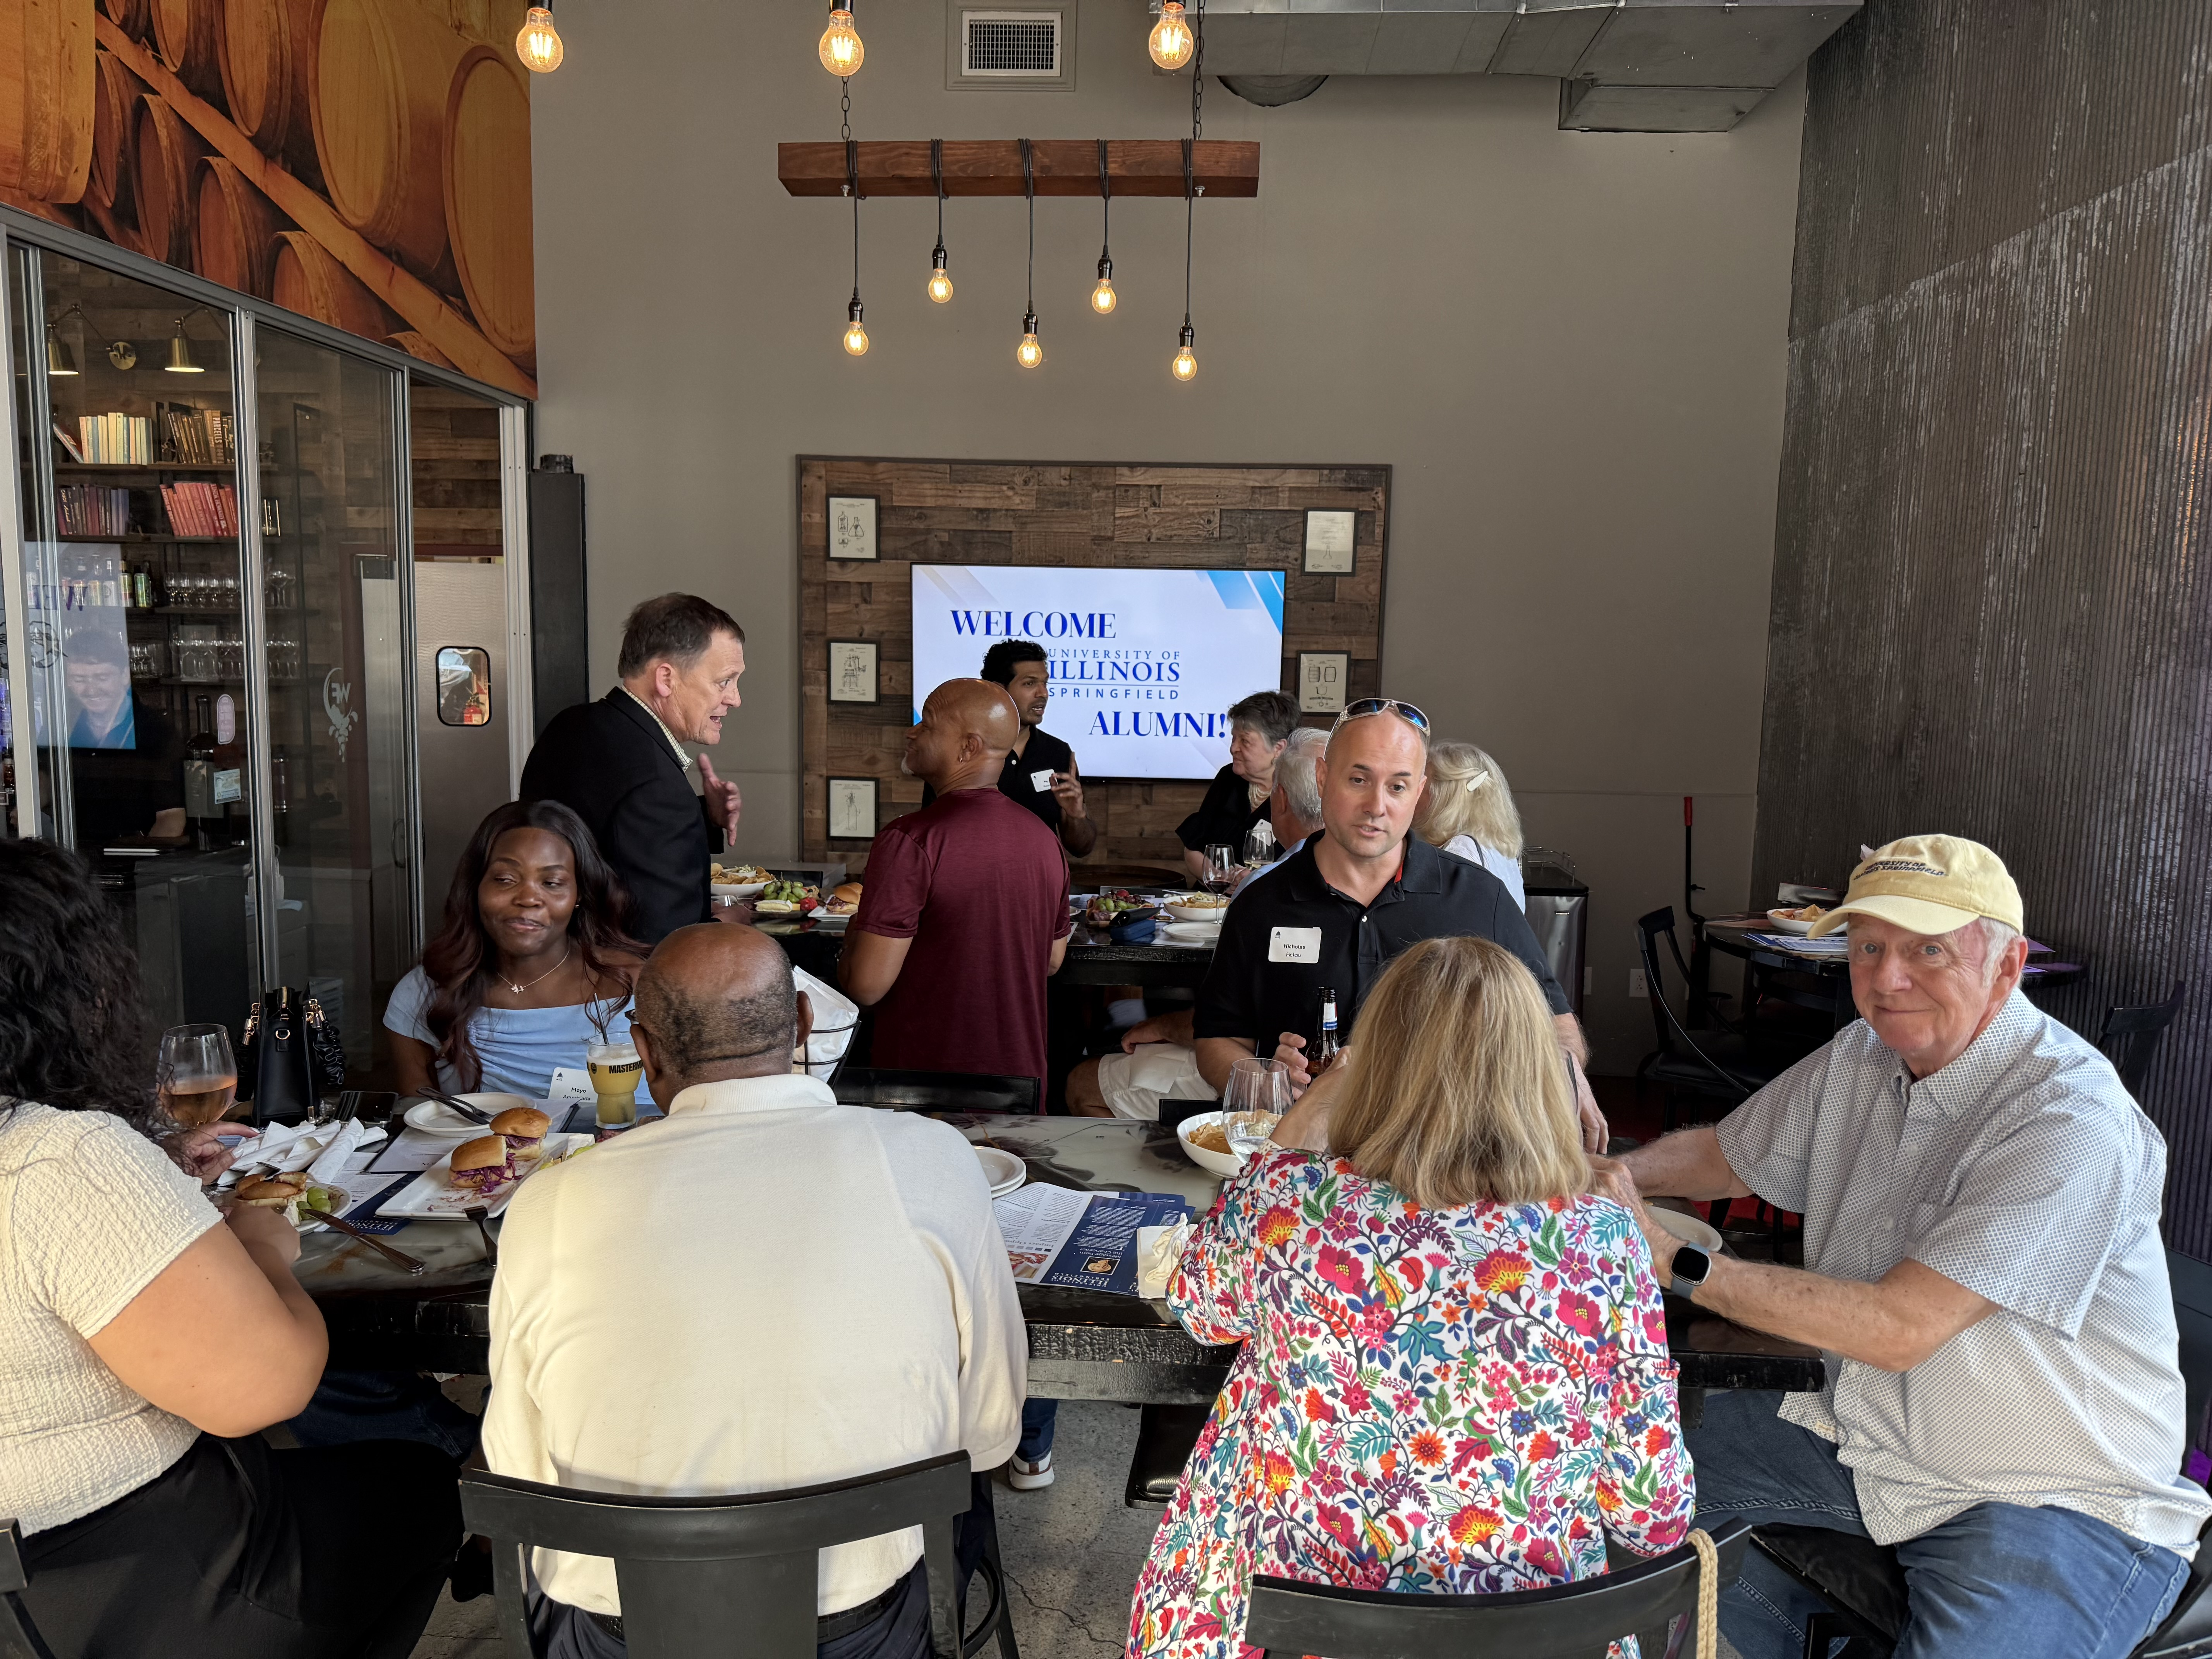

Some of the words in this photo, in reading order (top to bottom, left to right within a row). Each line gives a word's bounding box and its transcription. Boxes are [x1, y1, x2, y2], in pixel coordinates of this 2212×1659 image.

[213, 417, 222, 443] PARCELLS
[950, 610, 1116, 638] WELCOME
[1049, 649, 1152, 659] UNIVERSITY
[1162, 651, 1180, 660] OF
[1048, 660, 1180, 682] ILLINOIS
[1049, 688, 1178, 699] SPRINGFIELD
[1088, 711, 1226, 738] ALUMNI!
[1052, 1275, 1109, 1285] ILLINOIS
